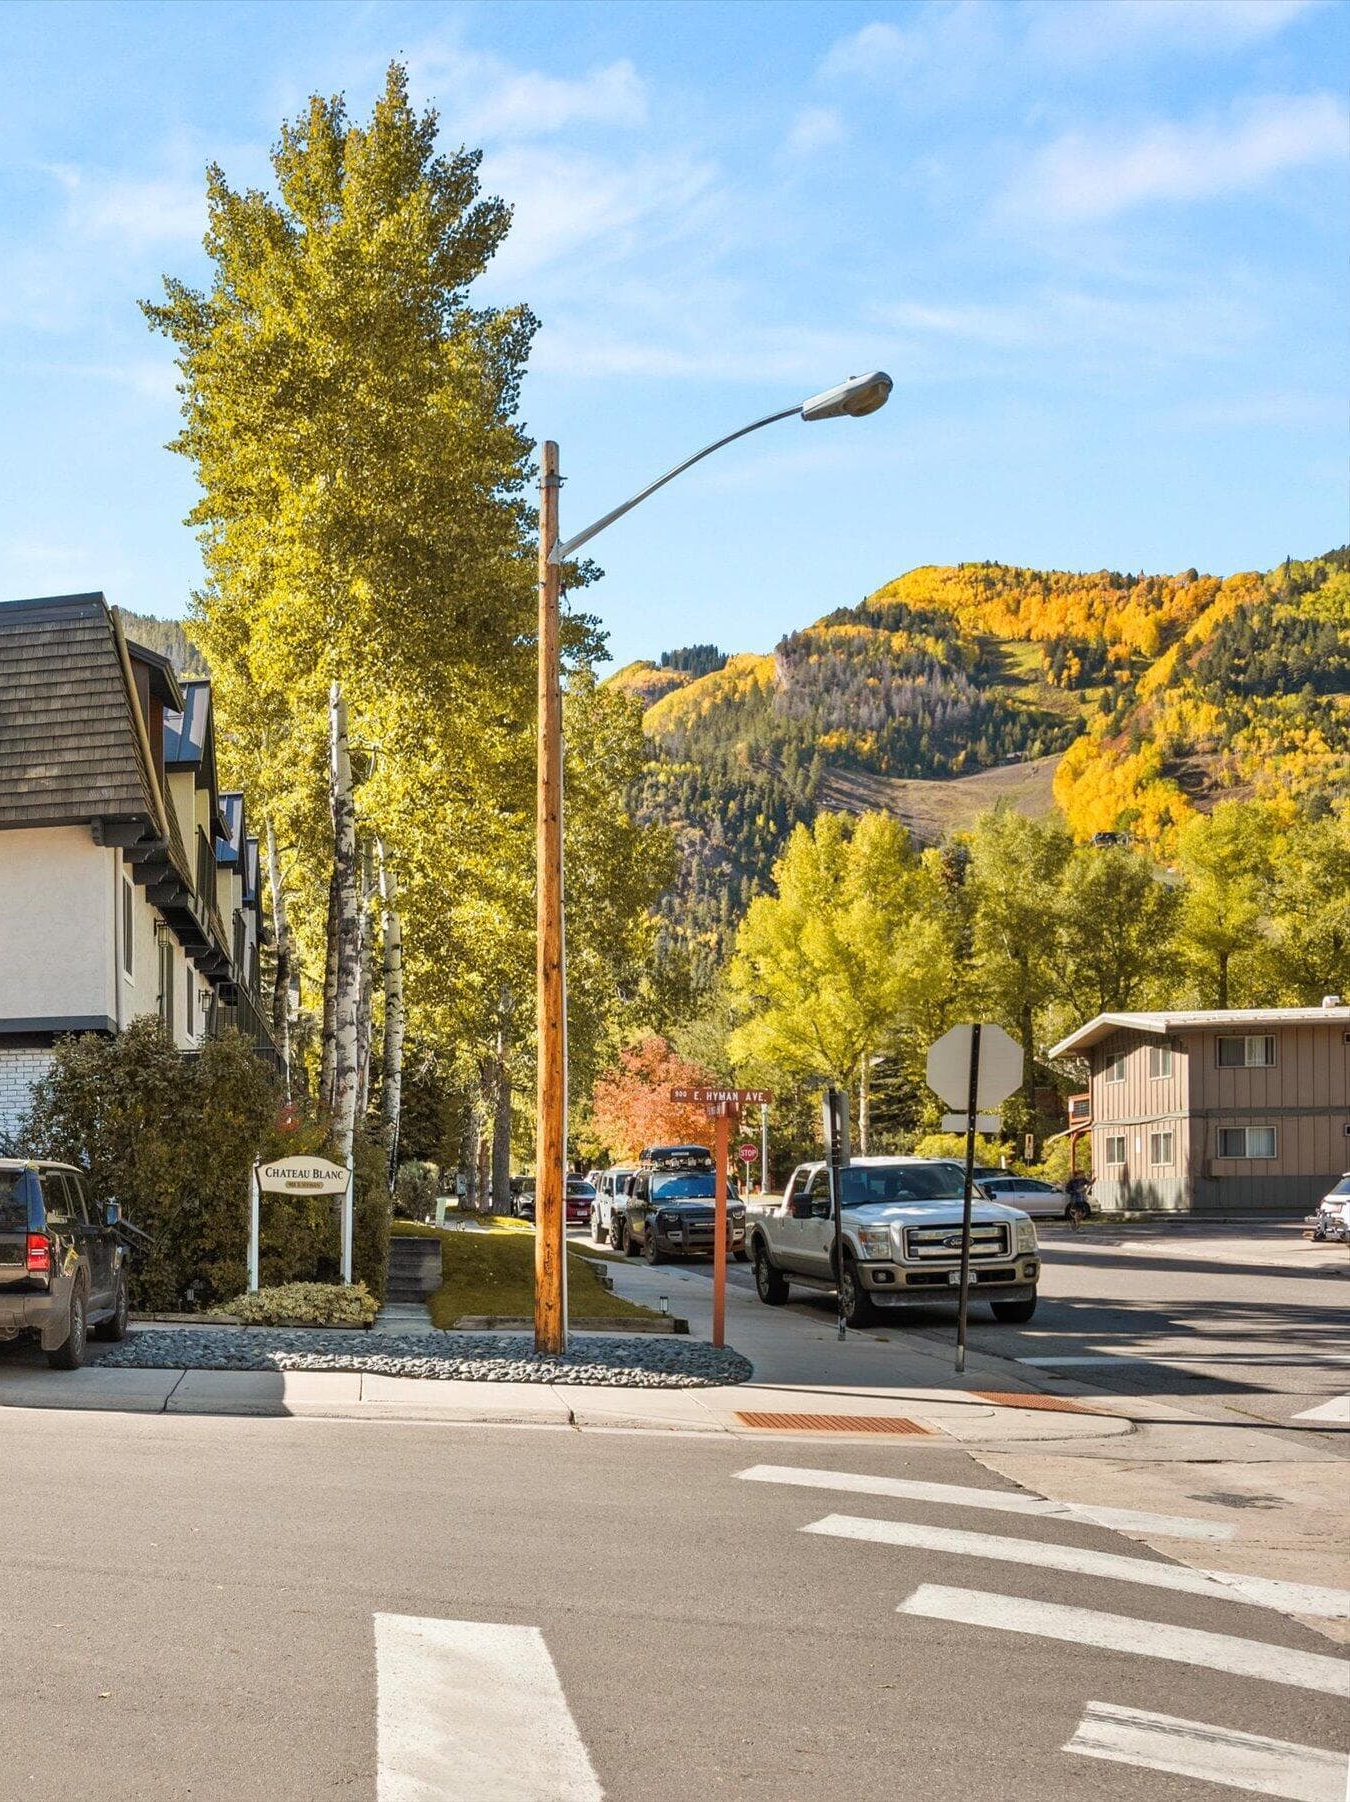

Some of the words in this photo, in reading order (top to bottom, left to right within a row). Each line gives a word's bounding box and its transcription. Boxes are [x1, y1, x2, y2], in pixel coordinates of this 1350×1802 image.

[674, 1090, 688, 1098] 900
[693, 1091, 702, 1101] E.
[706, 1091, 739, 1101] HYMAN
[745, 1091, 767, 1102] AVE.
[740, 1149, 757, 1157] STOP
[265, 1166, 310, 1179] CHATEAU
[312, 1168, 344, 1180] BLANC
